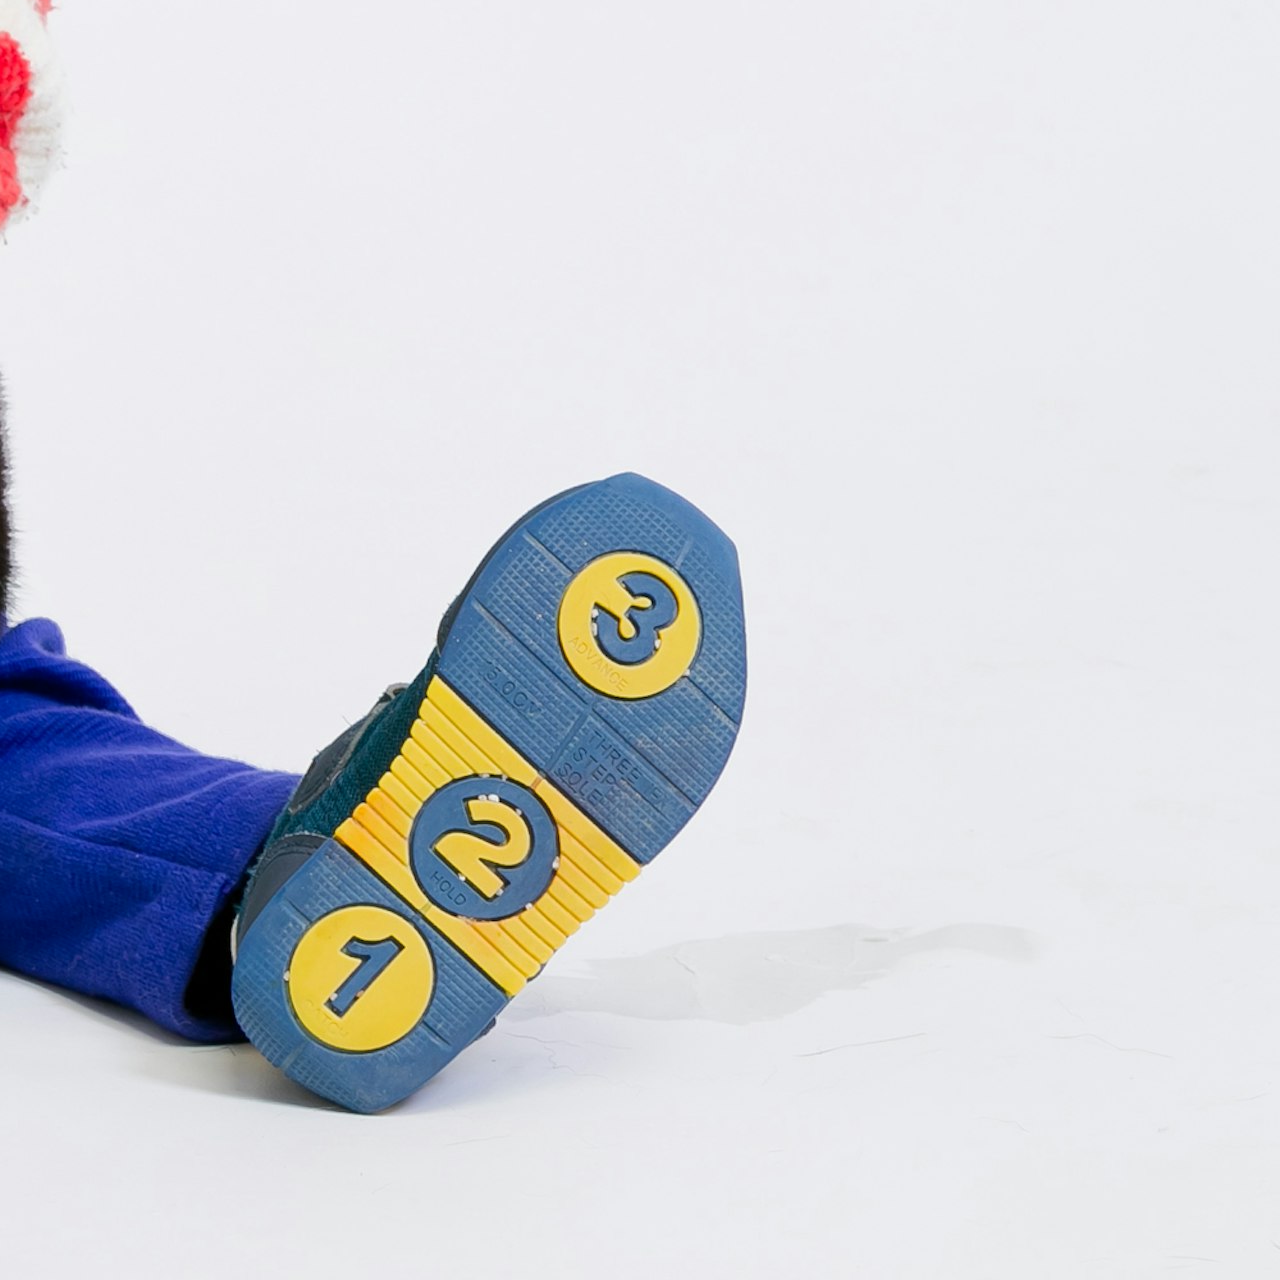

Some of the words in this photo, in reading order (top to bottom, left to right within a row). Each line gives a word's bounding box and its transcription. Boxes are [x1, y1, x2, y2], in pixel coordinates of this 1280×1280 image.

[591, 570, 679, 666] 3
[570, 637, 629, 691] ADVANCE
[554, 762, 602, 805] SOLE
[572, 746, 617, 786] STEP
[590, 730, 642, 784] THREE
[430, 794, 535, 902] 2
[430, 871, 467, 906] HOLD
[323, 935, 405, 1018] 1
